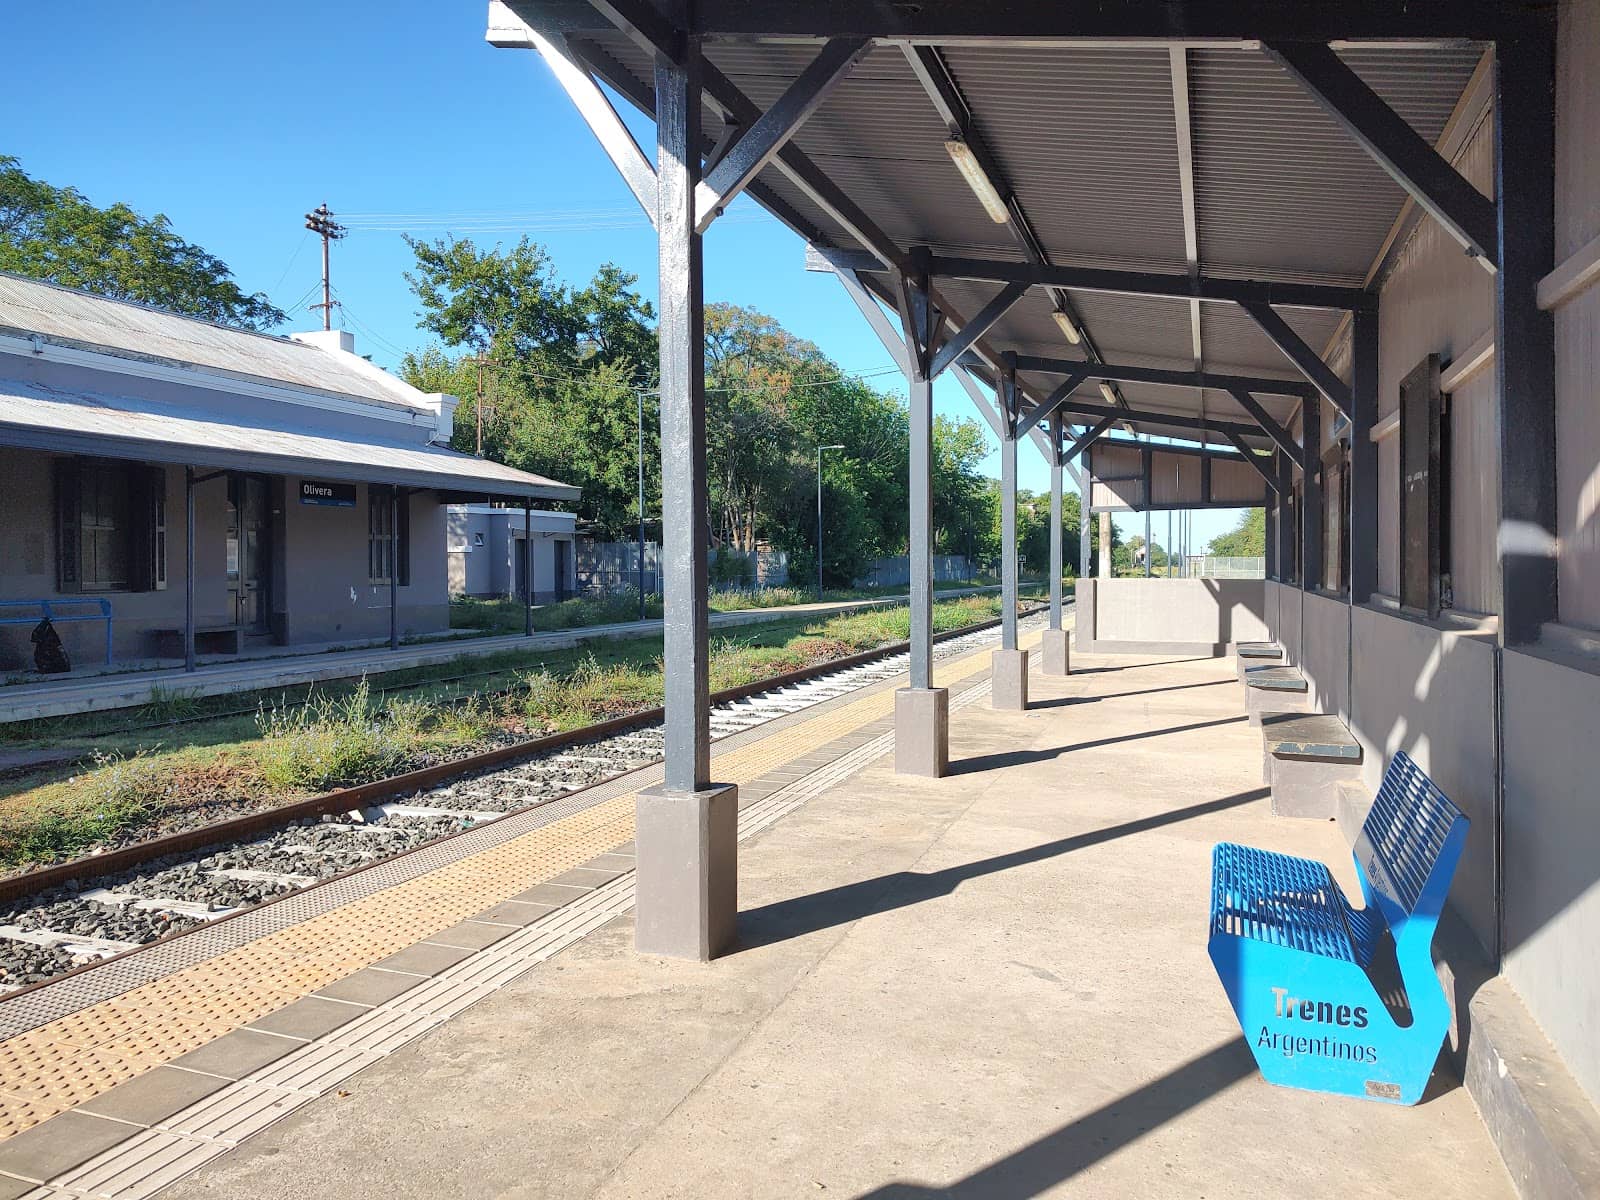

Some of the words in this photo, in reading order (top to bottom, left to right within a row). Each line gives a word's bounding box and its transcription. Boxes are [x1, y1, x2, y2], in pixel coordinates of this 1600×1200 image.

[303, 484, 333, 497] Olivera
[1271, 987, 1369, 1028] Trenes
[1257, 1025, 1377, 1063] Argentinos
